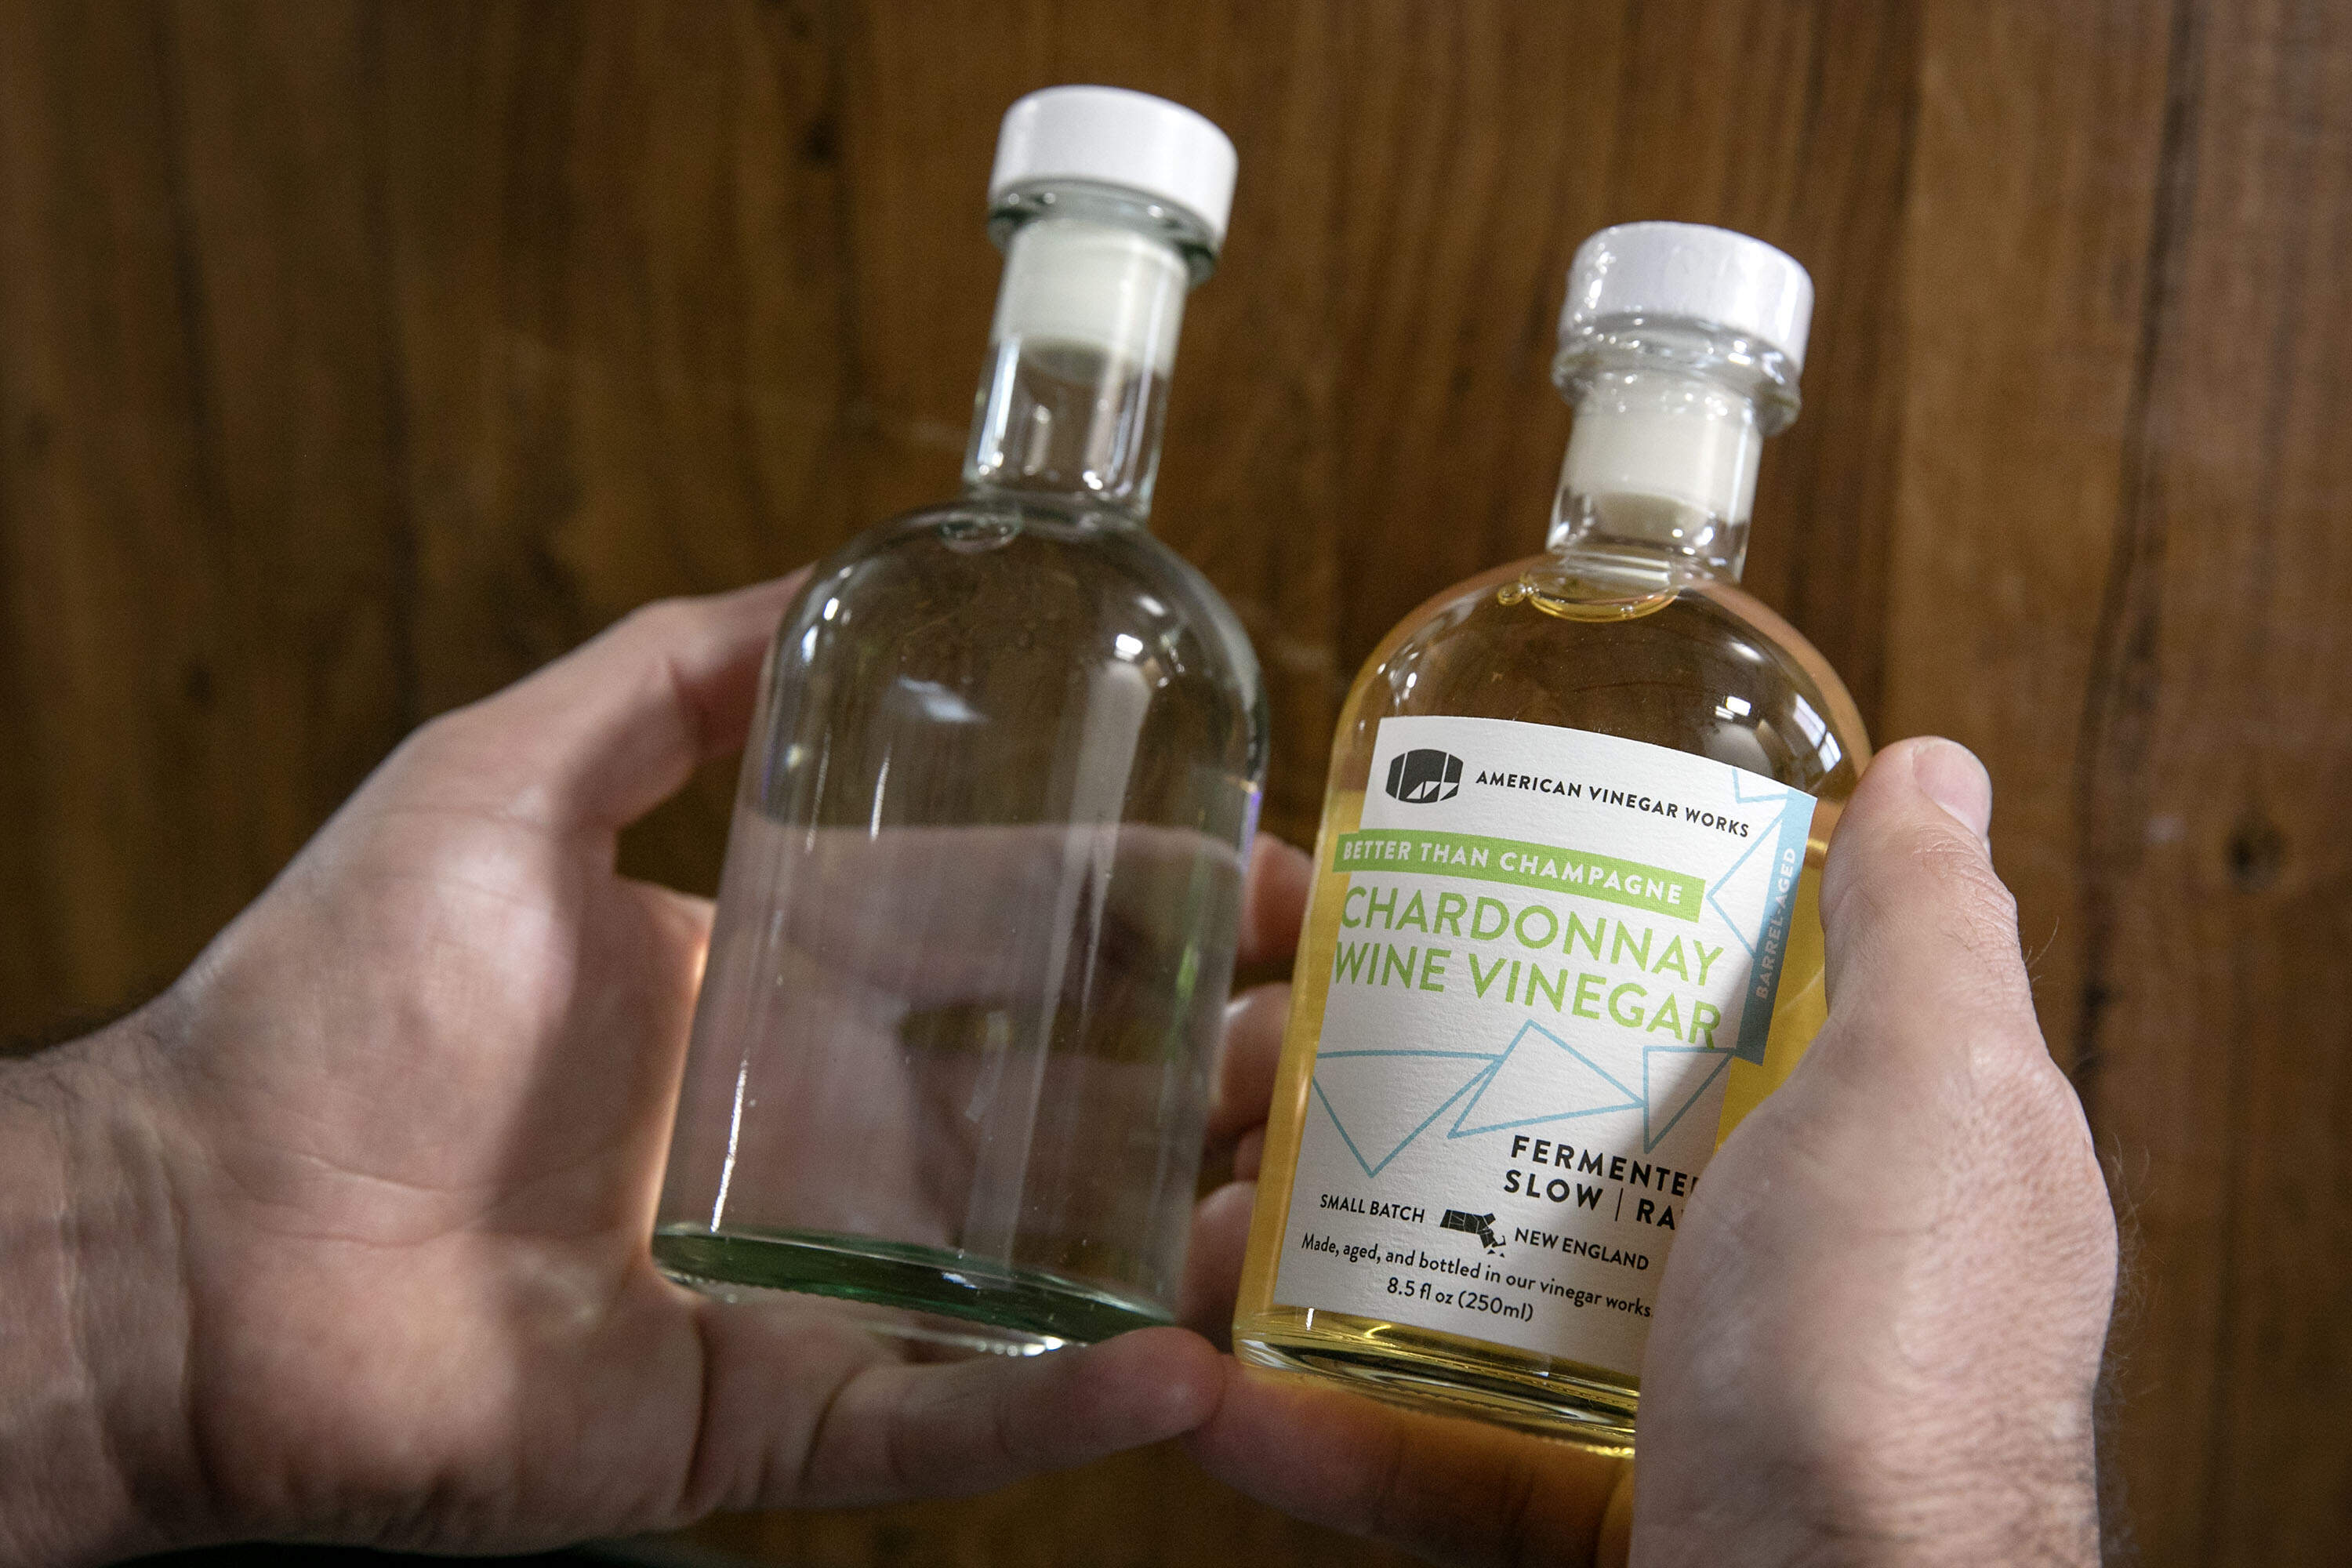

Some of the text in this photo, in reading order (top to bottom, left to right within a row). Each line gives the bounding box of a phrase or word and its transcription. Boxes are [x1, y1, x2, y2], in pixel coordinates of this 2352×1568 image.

[1475, 771, 1749, 837] AMERICAN VINEGAR WORKS
[1343, 840, 1682, 905] BETTER THAN CHAMPAGNE
[1341, 886, 1724, 986] CHARDONNAY
[1755, 847, 1797, 1000] BARREL-AGED
[1335, 941, 1722, 1050] WINE VINEGAR
[1320, 1194, 1649, 1270] SMALL BATCH NEW ENGLAND
[1504, 1169, 1683, 1230] SLOW RA
[1301, 1232, 1340, 1257] Made,
[1343, 1243, 1381, 1264] aged,
[1385, 1250, 1416, 1267] and
[1419, 1252, 1481, 1279] bottled
[1485, 1264, 1501, 1283] in
[1506, 1274, 1536, 1290] our
[1540, 1278, 1602, 1308] vinegar
[1387, 1276, 1534, 1322] 8.5 fl oz (250ml)
